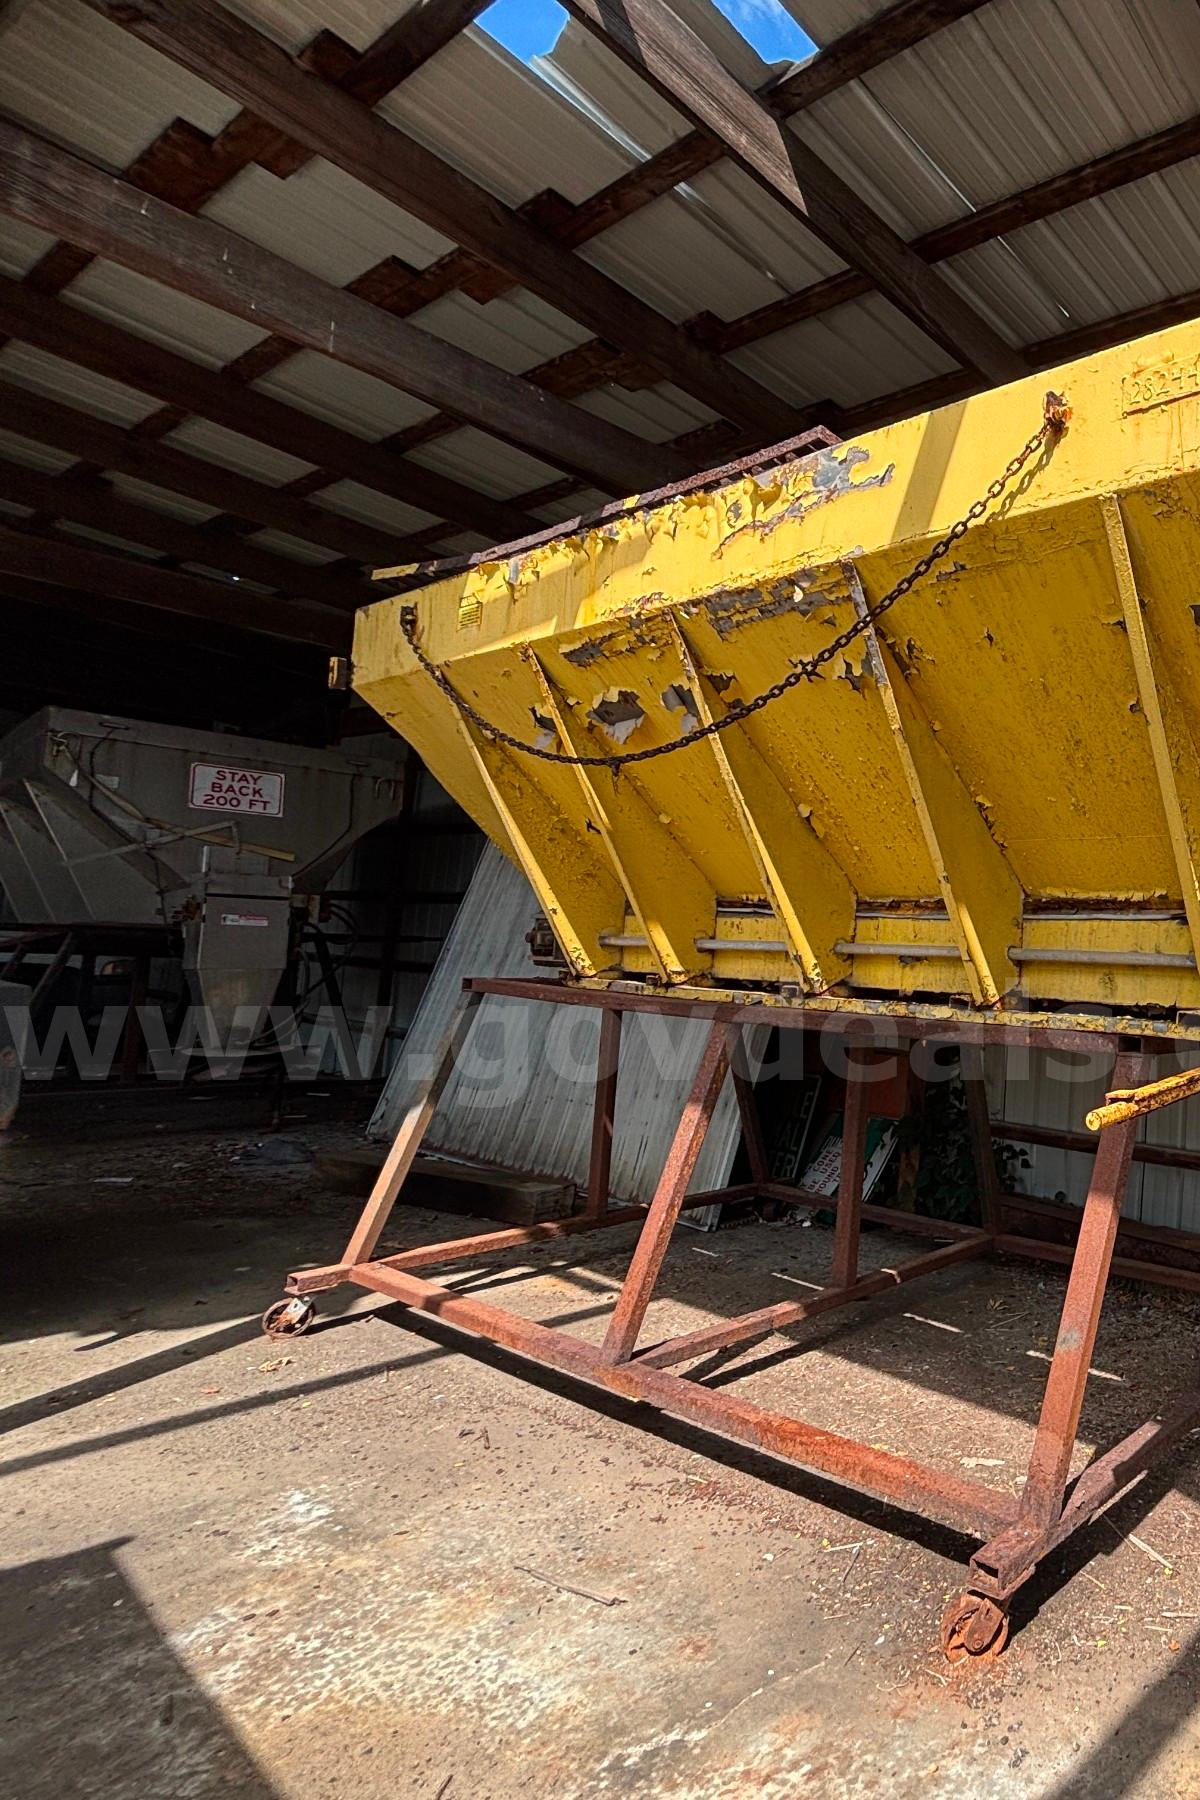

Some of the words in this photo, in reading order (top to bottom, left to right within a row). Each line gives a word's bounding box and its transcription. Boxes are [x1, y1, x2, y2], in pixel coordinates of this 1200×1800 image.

[215, 769, 264, 786] STAY
[211, 781, 264, 798] BACK
[203, 793, 242, 808] 200
[248, 798, 271, 811] FT
